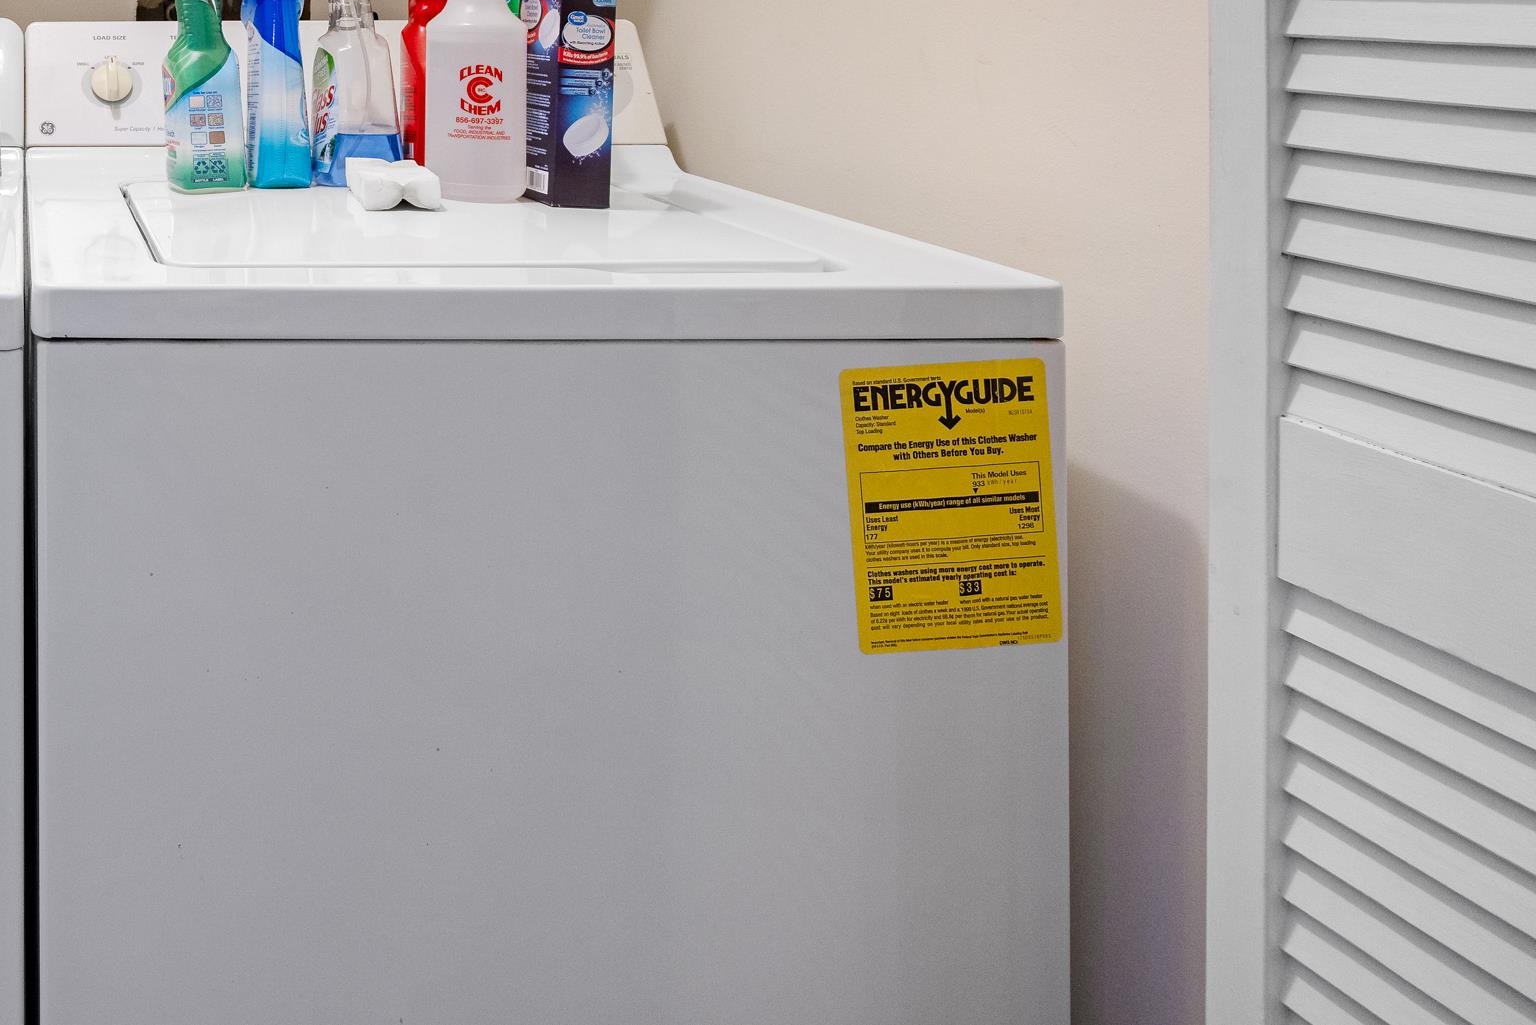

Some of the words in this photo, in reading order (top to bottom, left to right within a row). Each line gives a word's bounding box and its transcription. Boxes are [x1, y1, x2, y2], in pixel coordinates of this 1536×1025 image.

[460, 65, 503, 83] CLEAN
[460, 98, 501, 116] CHEM
[455, 117, 504, 125] 856-697-3397
[853, 376, 1035, 412] ENERGYGUIDE
[858, 443, 893, 453] Compare
[894, 441, 907, 450] the
[908, 440, 934, 450] Energy
[936, 439, 951, 447] Use
[952, 438, 960, 446] of
[961, 437, 977, 445] this
[978, 435, 1007, 444] Clothes
[1008, 433, 1037, 442] Washer
[893, 452, 911, 461] with
[912, 450, 939, 459] Others
[941, 449, 968, 457] Before
[969, 447, 985, 456] You
[986, 446, 1004, 456] Buy.
[971, 472, 986, 480] This
[879, 503, 900, 511] Energy
[912, 499, 946, 509] (kWh/year)
[946, 499, 965, 507] range
[981, 495, 1003, 503] similar
[1003, 494, 1026, 502] models
[1009, 507, 1025, 515] Uses
[882, 515, 899, 523] Least
[867, 524, 888, 532] Energy
[867, 570, 891, 578] Clothes
[893, 569, 919, 577] washers
[1019, 560, 1045, 568] operate.
[942, 574, 962, 582] yearly
[963, 572, 993, 581] operating
[870, 587, 891, 600] $75
[960, 581, 980, 594] $33
